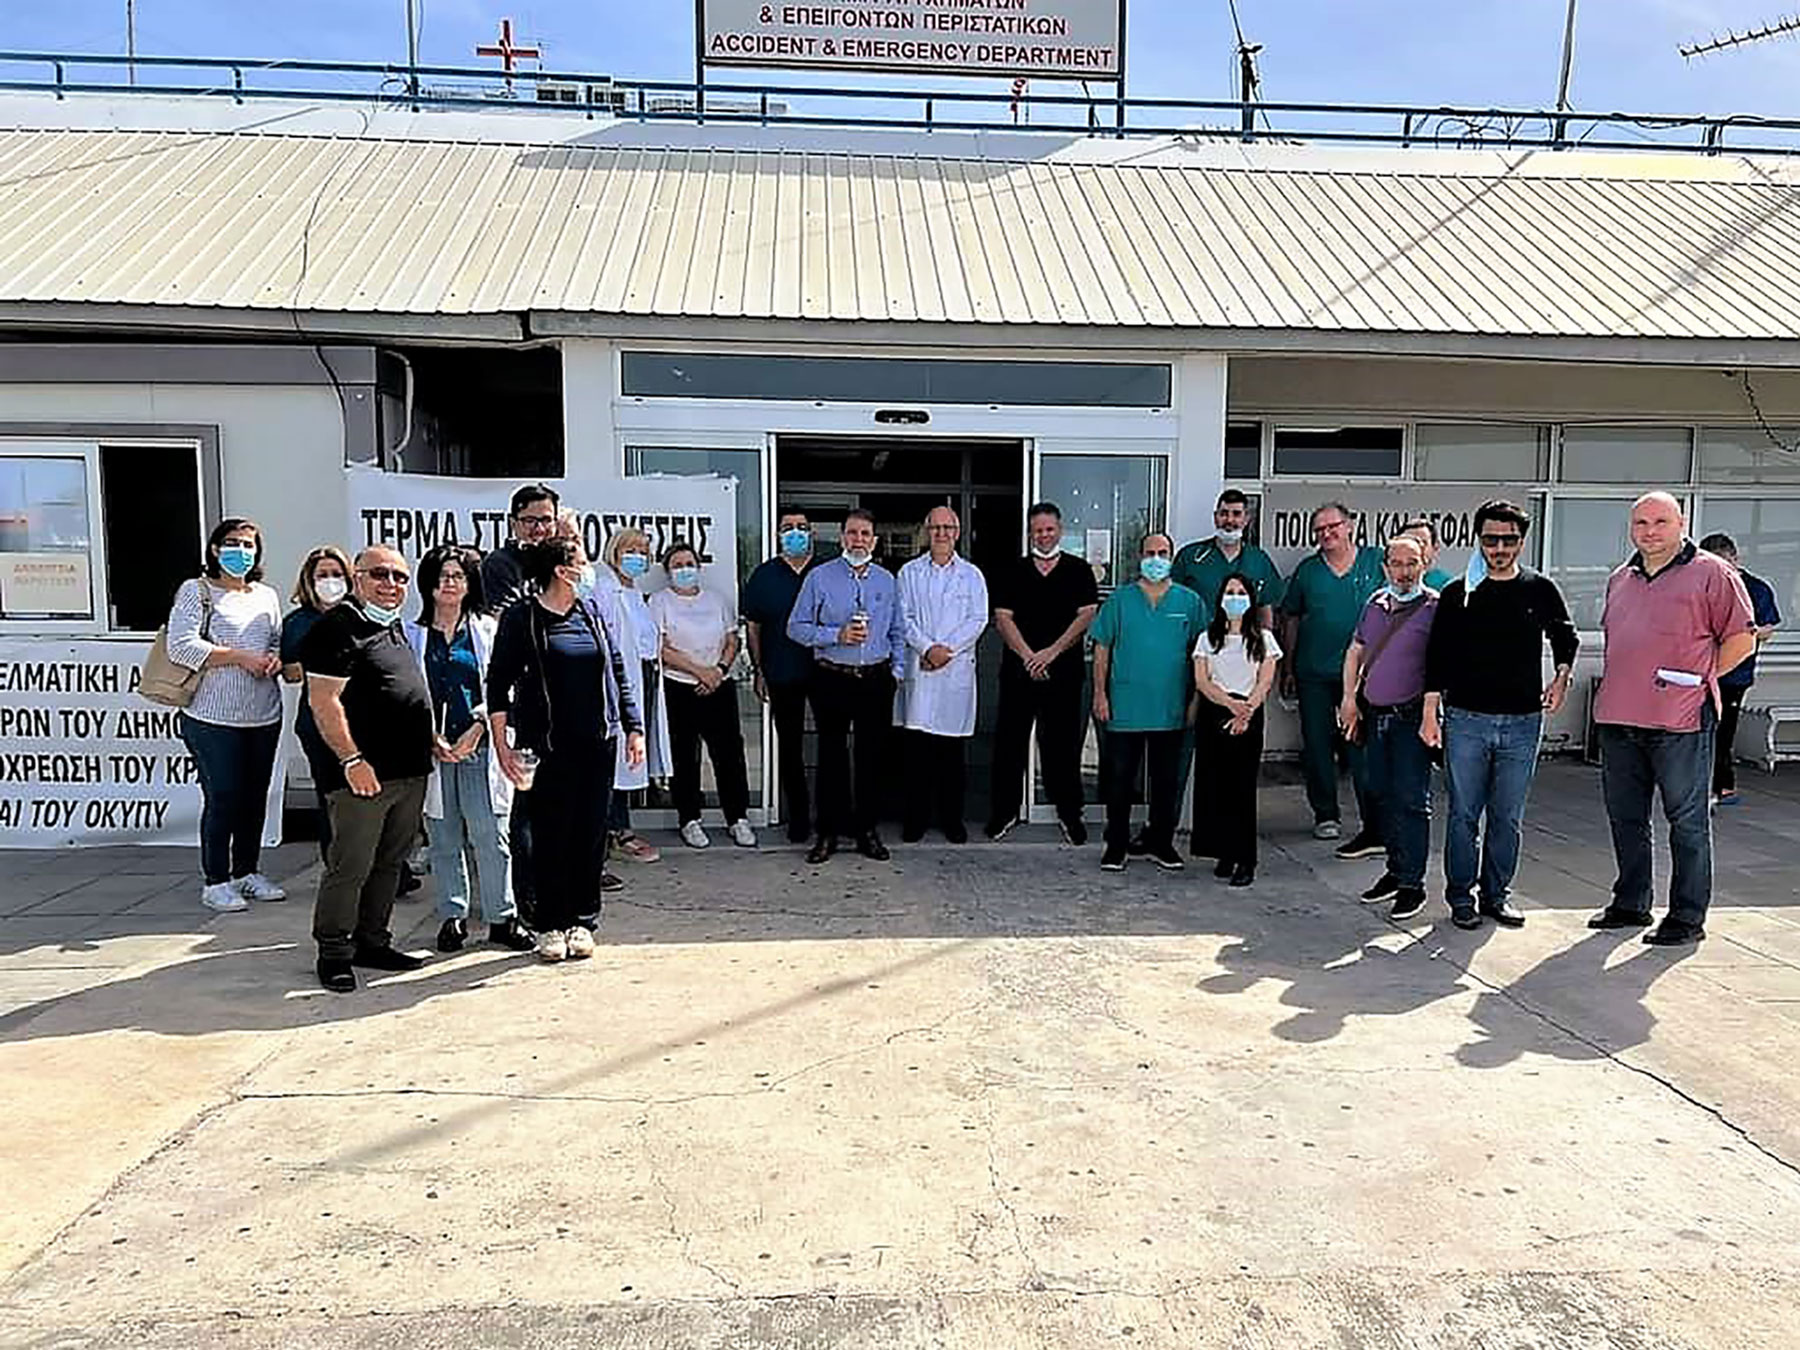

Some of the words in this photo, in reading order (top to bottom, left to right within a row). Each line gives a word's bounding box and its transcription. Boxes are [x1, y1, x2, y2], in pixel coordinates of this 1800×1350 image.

[759, 6, 773, 23] &
[783, 7, 914, 28] ΕΠΕΙΓΟΝΤΩΝ
[923, 14, 1066, 35] ΠΕΡΙΣΤΑΤΙΚΩΝ
[711, 34, 817, 55] ACCIDENT
[823, 38, 837, 56] &
[843, 39, 971, 62] EMERGENCY
[977, 45, 1112, 67] DEPARTMENT
[59, 710, 107, 739] ΤΟΥ
[109, 755, 156, 785] ΤΟΥ
[32, 800, 78, 828] ΤΟΥ
[85, 801, 169, 829] ΟΚΥΠΥ
